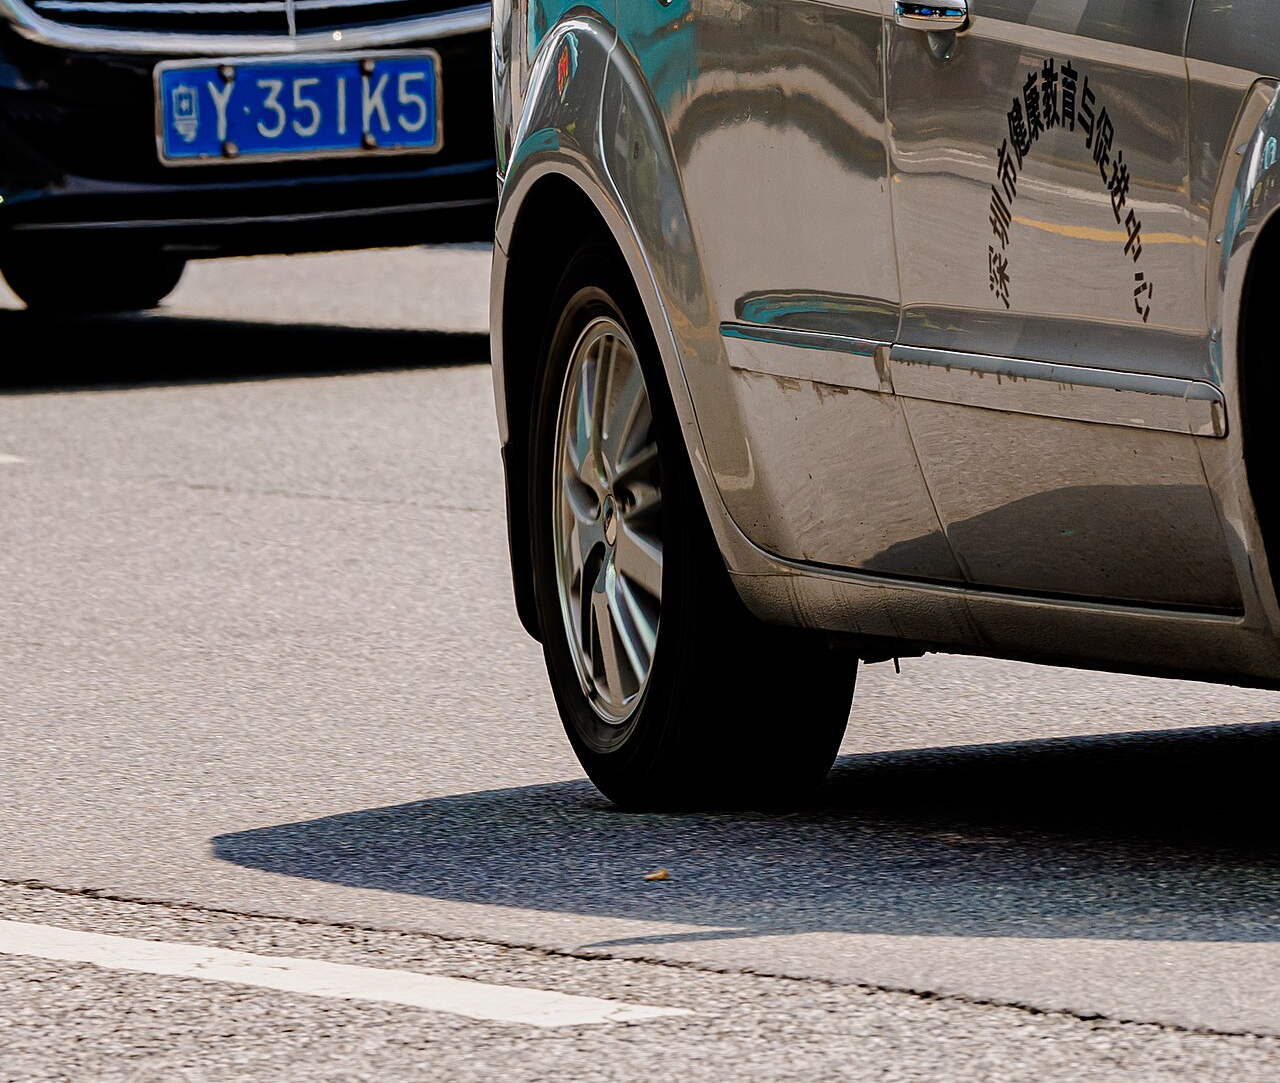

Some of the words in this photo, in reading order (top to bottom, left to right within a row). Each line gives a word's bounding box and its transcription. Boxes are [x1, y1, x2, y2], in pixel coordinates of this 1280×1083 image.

[989, 58, 1153, 323] 深圳市健康教育与促进中心
